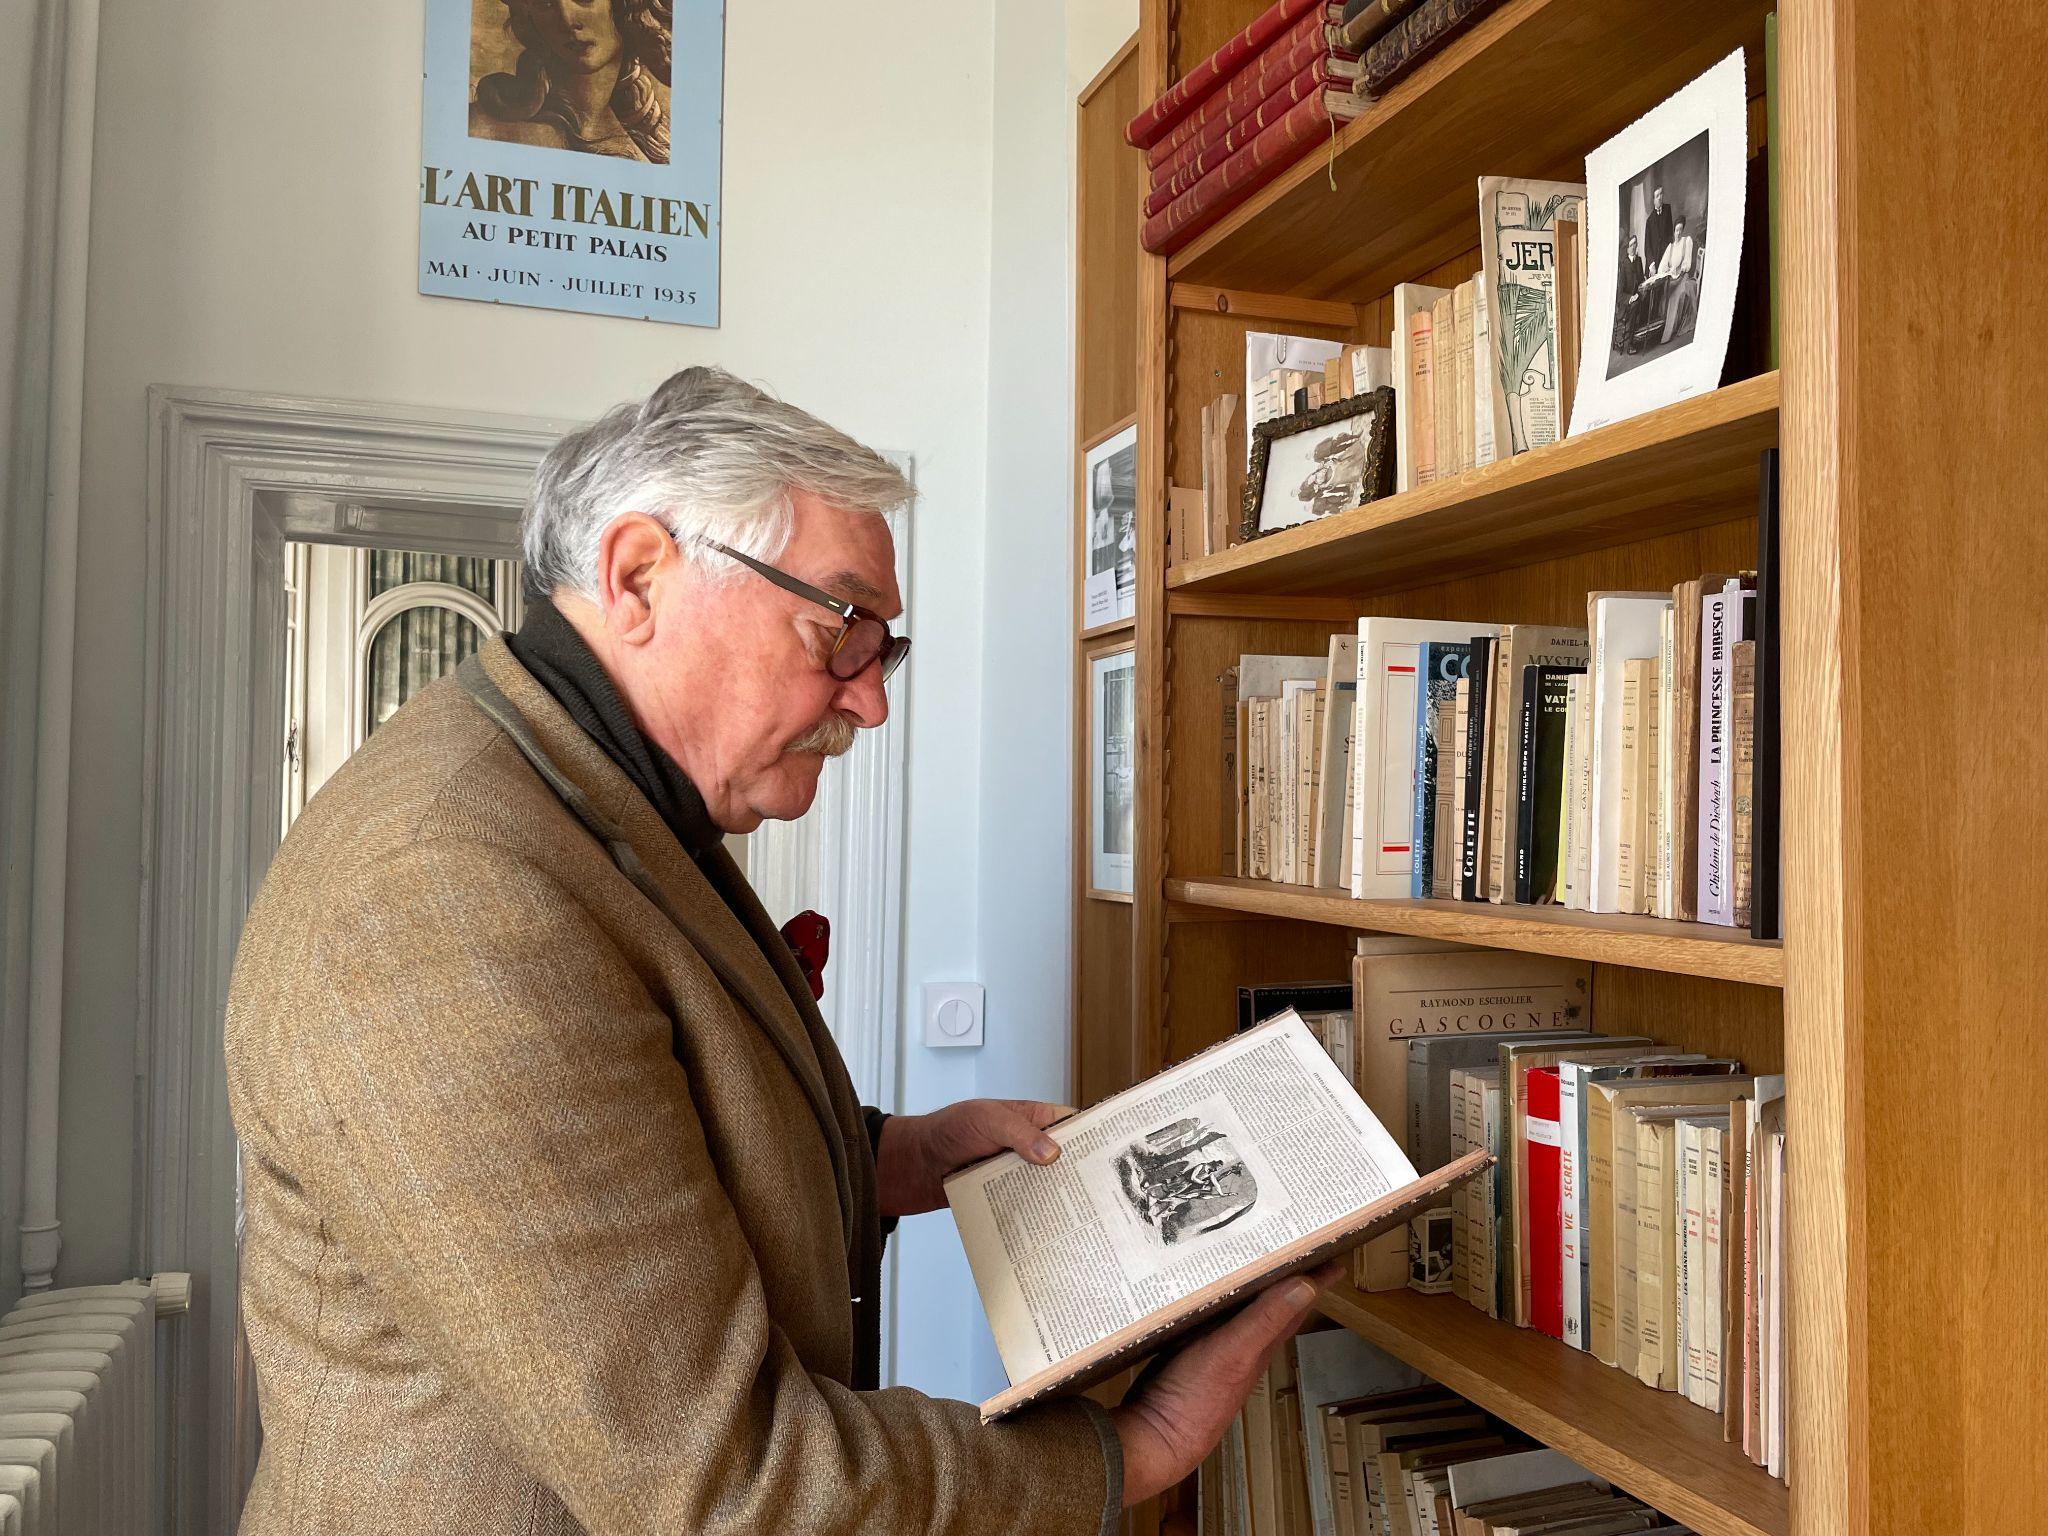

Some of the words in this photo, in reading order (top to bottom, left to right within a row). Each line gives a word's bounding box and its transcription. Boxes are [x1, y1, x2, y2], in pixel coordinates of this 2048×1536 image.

[423, 166, 539, 217] L'ART
[551, 182, 712, 240] ITALIEN
[462, 222, 496, 242] AU
[507, 227, 577, 252] PETIT
[589, 236, 668, 263] PALAIS
[427, 260, 470, 279] MAI
[487, 268, 541, 287] JUIN
[562, 277, 644, 299] JUILLET
[653, 287, 697, 305] 1935
[1712, 601, 1723, 661] BIBESCO
[1711, 666, 1723, 743] PRINCESSE
[1711, 746, 1721, 764] LA
[1463, 810, 1475, 877] COLETTE
[1709, 847, 1720, 897] Ghislain
[1420, 998, 1474, 1008] RAYMOND
[1479, 995, 1534, 1006] ESCHOLIER
[1565, 1211, 1573, 1231] VIE
[1565, 1244, 1575, 1259] LA
